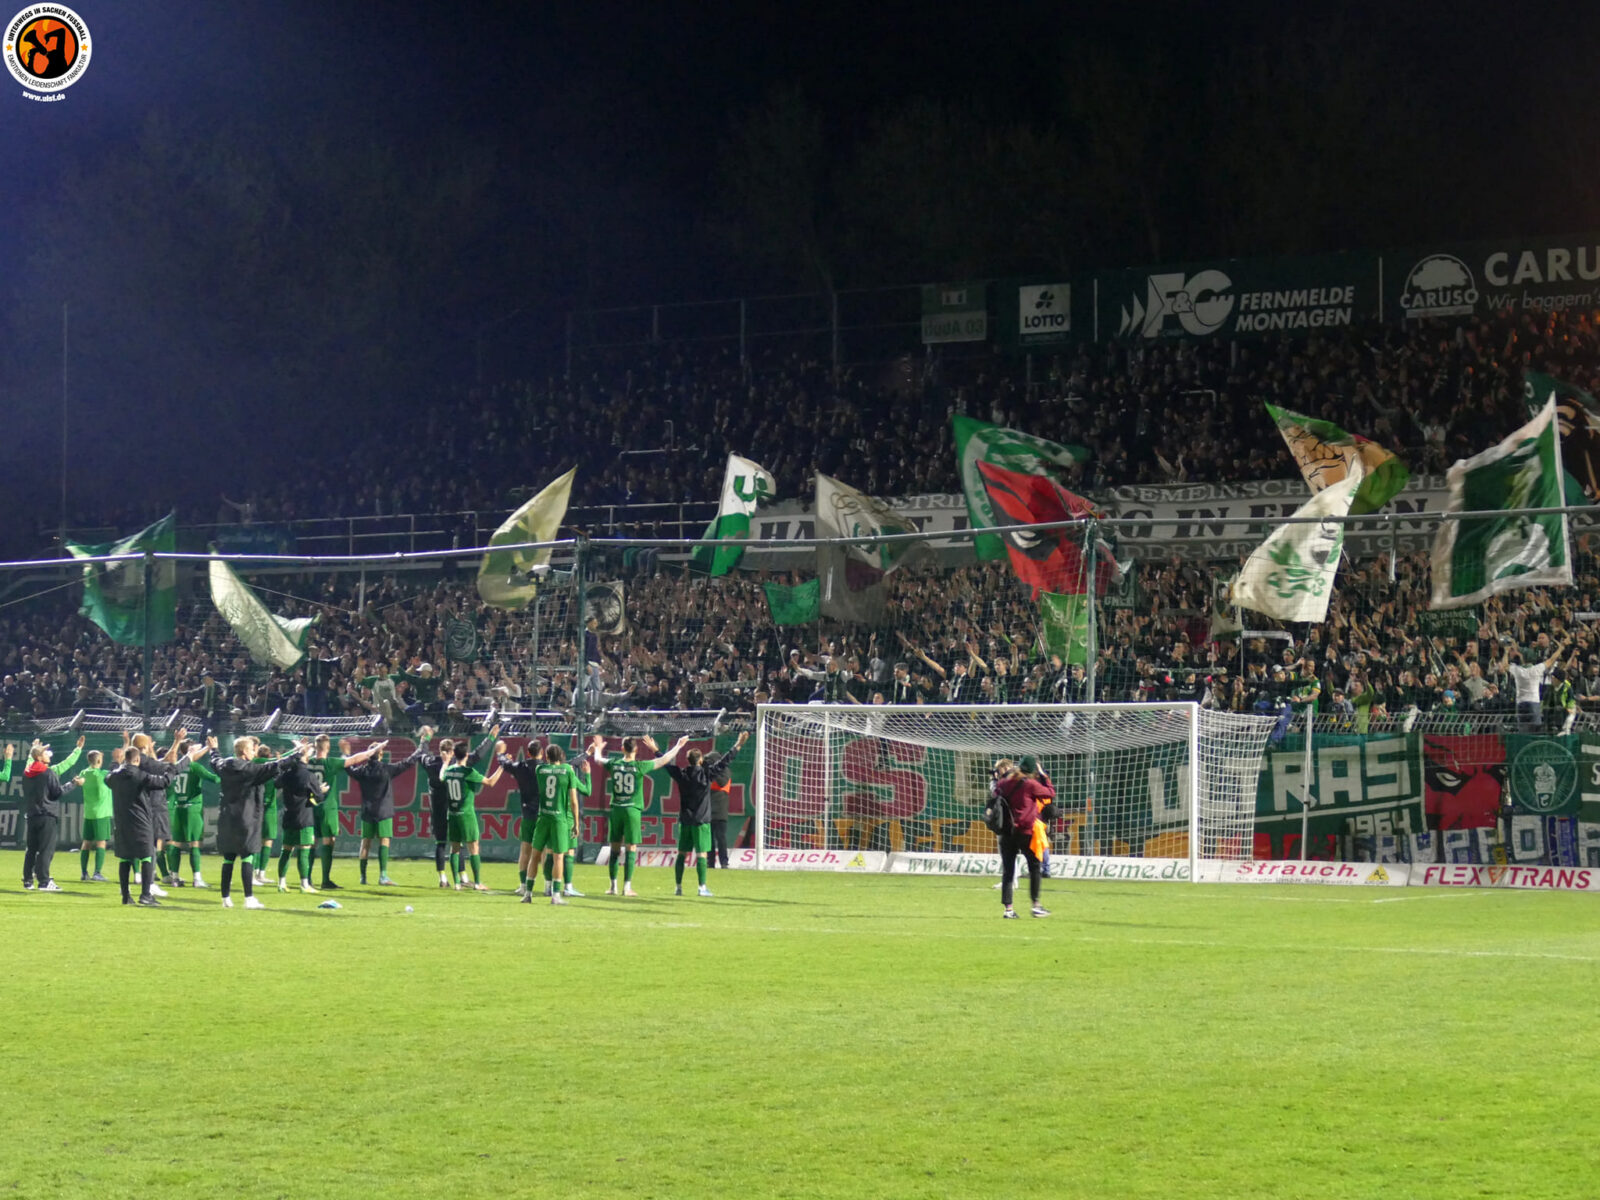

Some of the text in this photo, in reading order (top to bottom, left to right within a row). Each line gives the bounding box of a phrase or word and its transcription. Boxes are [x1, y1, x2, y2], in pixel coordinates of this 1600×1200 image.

[1239, 285, 1355, 312] FERNMELDE
[1400, 288, 1479, 310] CARUSO
[1485, 293, 1518, 312] Wir
[1025, 314, 1065, 329] LOTTO
[1235, 307, 1352, 333] MONTAGEN
[174, 772, 189, 794] 37
[446, 778, 462, 801] 10
[545, 775, 557, 799] 8
[613, 771, 636, 795] 39
[1346, 808, 1412, 837] 1964
[740, 849, 841, 864] Srauch.
[908, 856, 1191, 880] www.tisceei-thieme.de
[1236, 862, 1359, 878] Strauch.
[1423, 866, 1592, 889] FLEX TRANS
